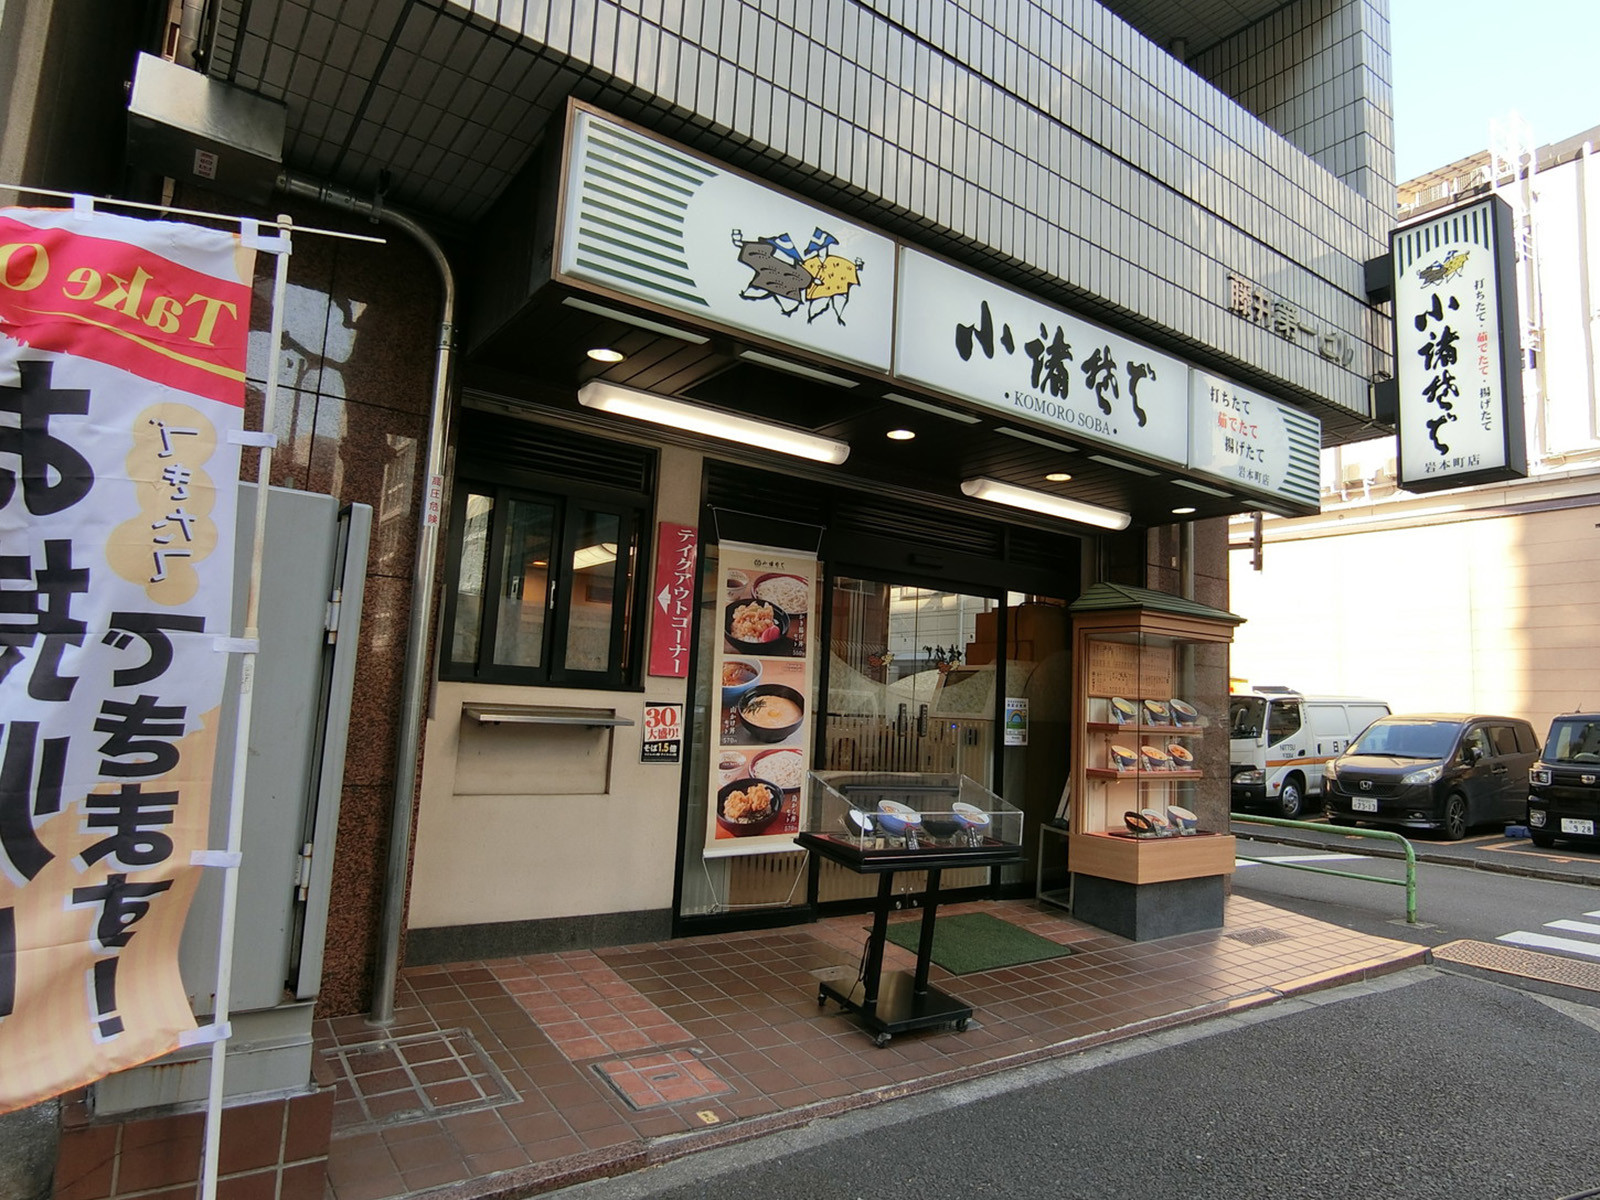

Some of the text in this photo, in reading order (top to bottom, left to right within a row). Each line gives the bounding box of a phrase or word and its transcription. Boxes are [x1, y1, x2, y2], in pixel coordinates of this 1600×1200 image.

[1013, 391, 1111, 436] KOMORO SOBA
[1210, 386, 1251, 415] 打ちたて
[1217, 411, 1258, 439] 茹でたて
[1225, 436, 1265, 463] 揚げたて
[1238, 465, 1271, 487] 岩本町店
[1425, 454, 1481, 474] 岩本町店
[428, 476, 442, 525] 高圧危険
[668, 528, 696, 674] テイクアウトコーナー
[645, 707, 677, 728] 30
